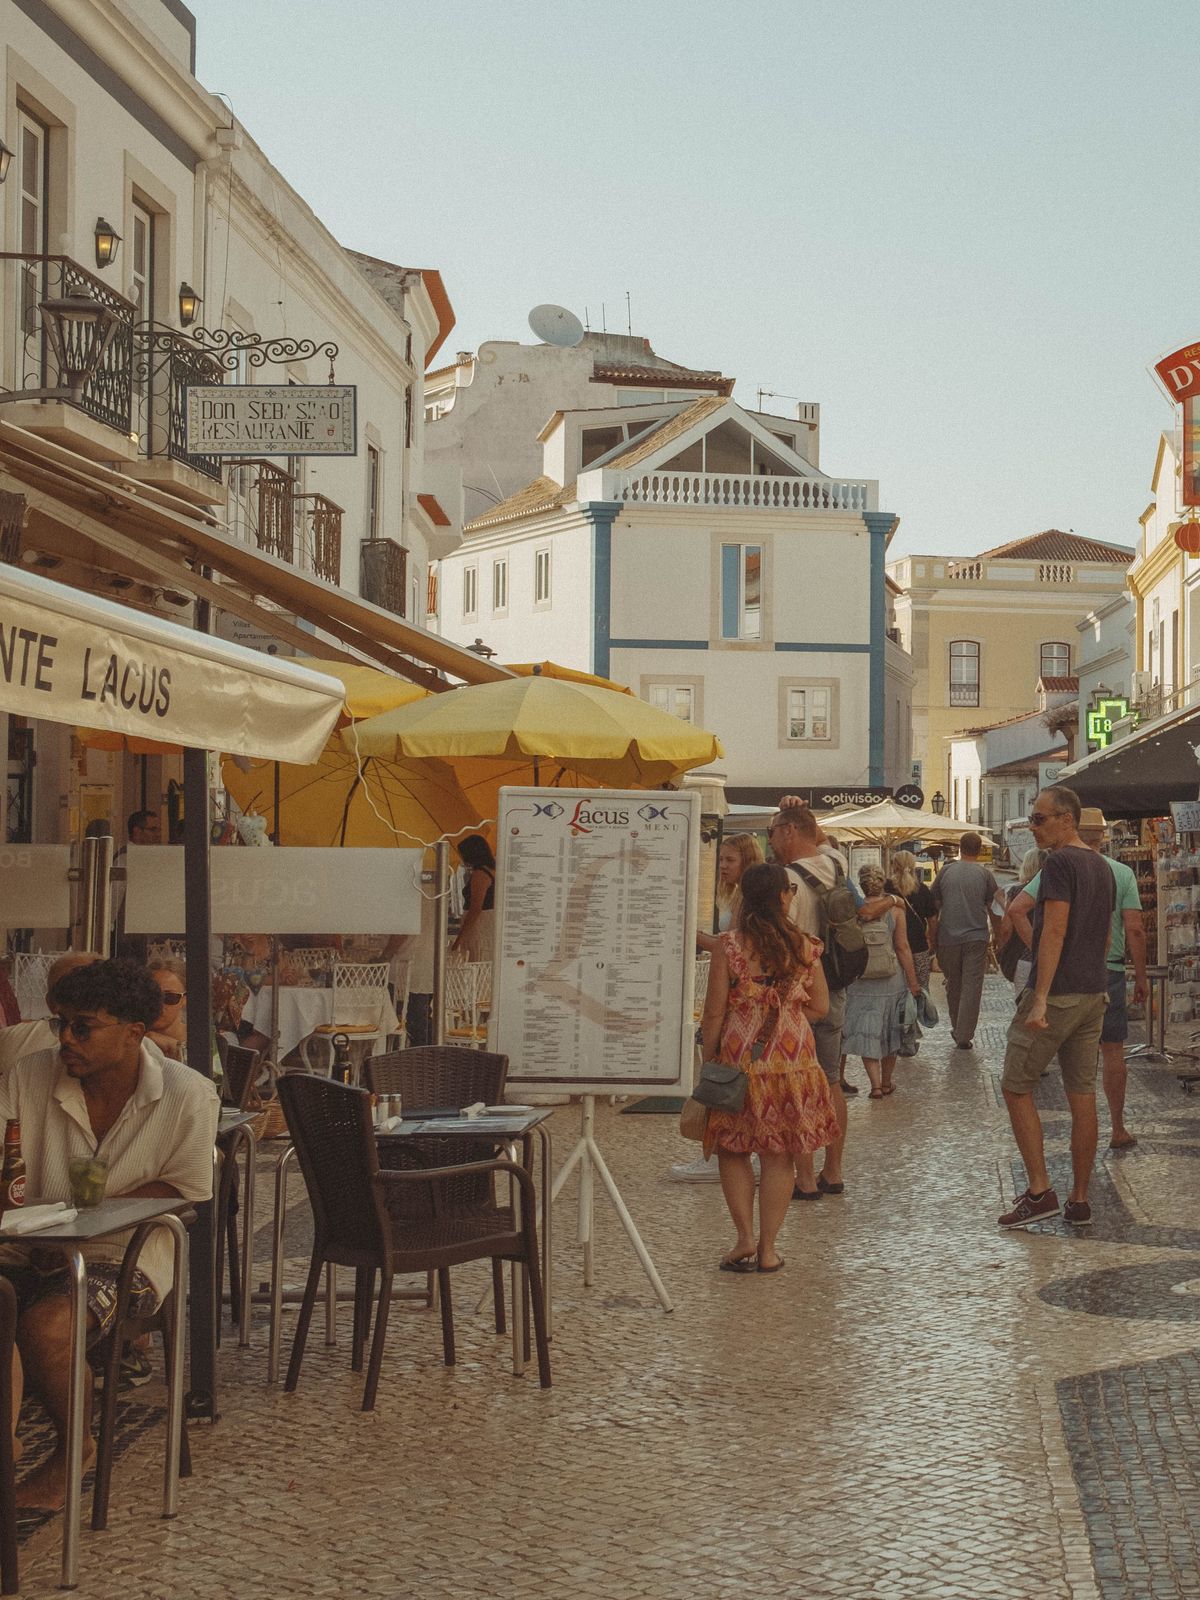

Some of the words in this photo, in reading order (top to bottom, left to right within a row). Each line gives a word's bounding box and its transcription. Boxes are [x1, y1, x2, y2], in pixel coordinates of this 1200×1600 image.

[81, 647, 172, 718] LACUS
[1094, 719, 1112, 732] 18
[822, 792, 883, 806] optivisão
[566, 798, 630, 833] Lacus
[644, 823, 680, 832] MENU
